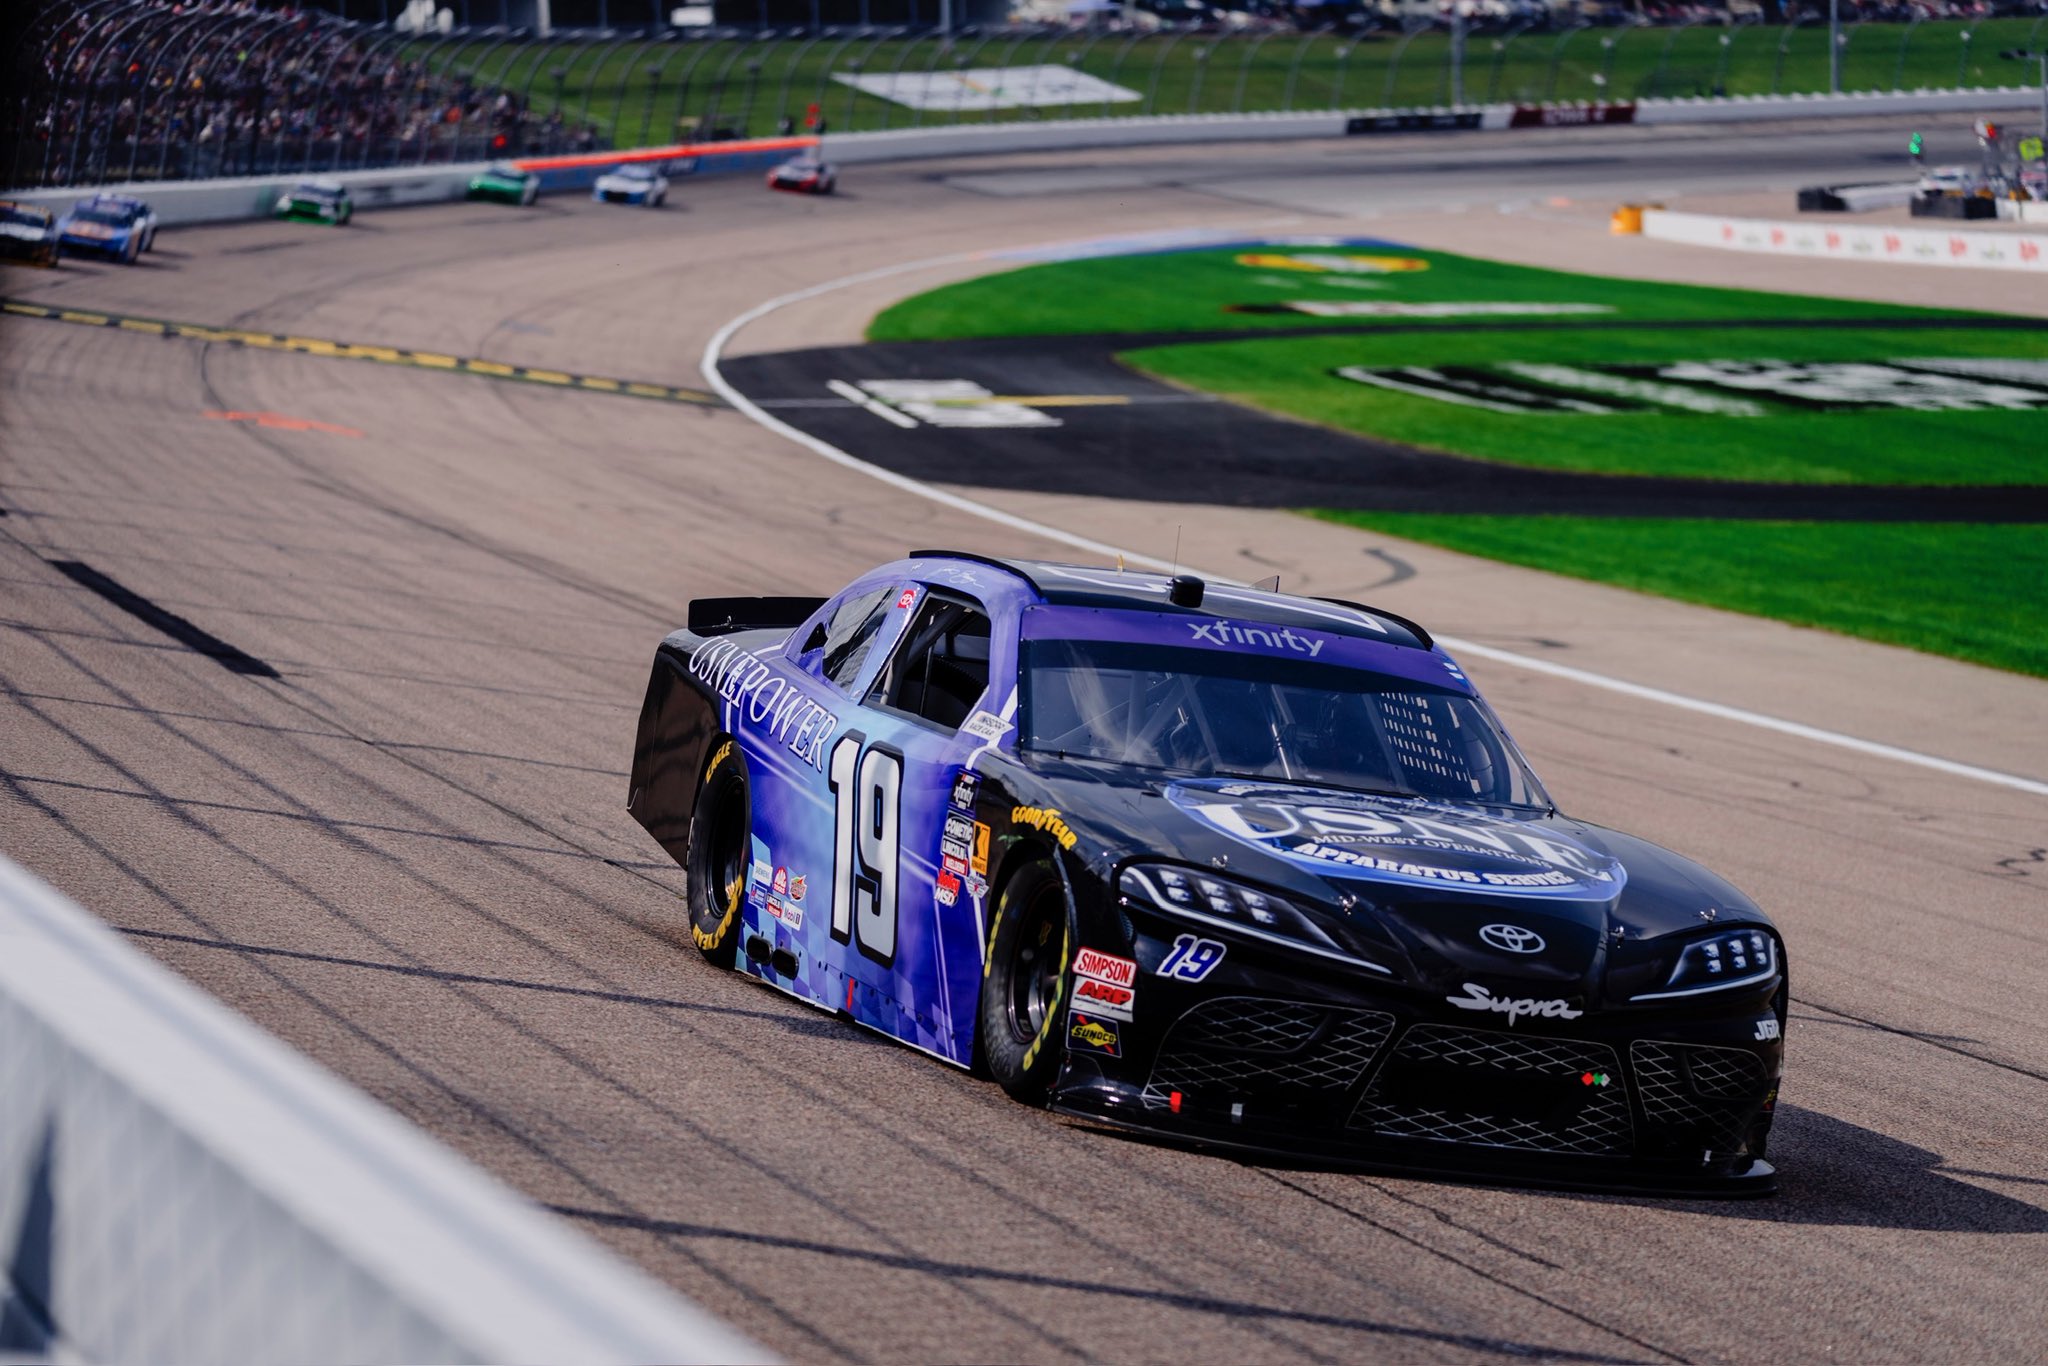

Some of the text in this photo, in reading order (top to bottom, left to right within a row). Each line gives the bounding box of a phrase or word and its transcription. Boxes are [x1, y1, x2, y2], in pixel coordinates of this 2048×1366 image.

[1187, 620, 1324, 657] xfinity
[705, 740, 733, 785] EAGLE
[1011, 806, 1078, 851] GOODYEAR
[829, 730, 904, 969] 19
[1293, 842, 1576, 887] APPARATUS SERVICE
[1312, 834, 1553, 869] MID-WEST OPERATIONS
[934, 887, 958, 906] MSD
[1078, 952, 1132, 984] SIMPSON
[1156, 933, 1227, 983] 19
[1077, 980, 1132, 1005] ARP
[1446, 983, 1583, 1027] Supra
[1073, 1026, 1117, 1044] SUNOCO
